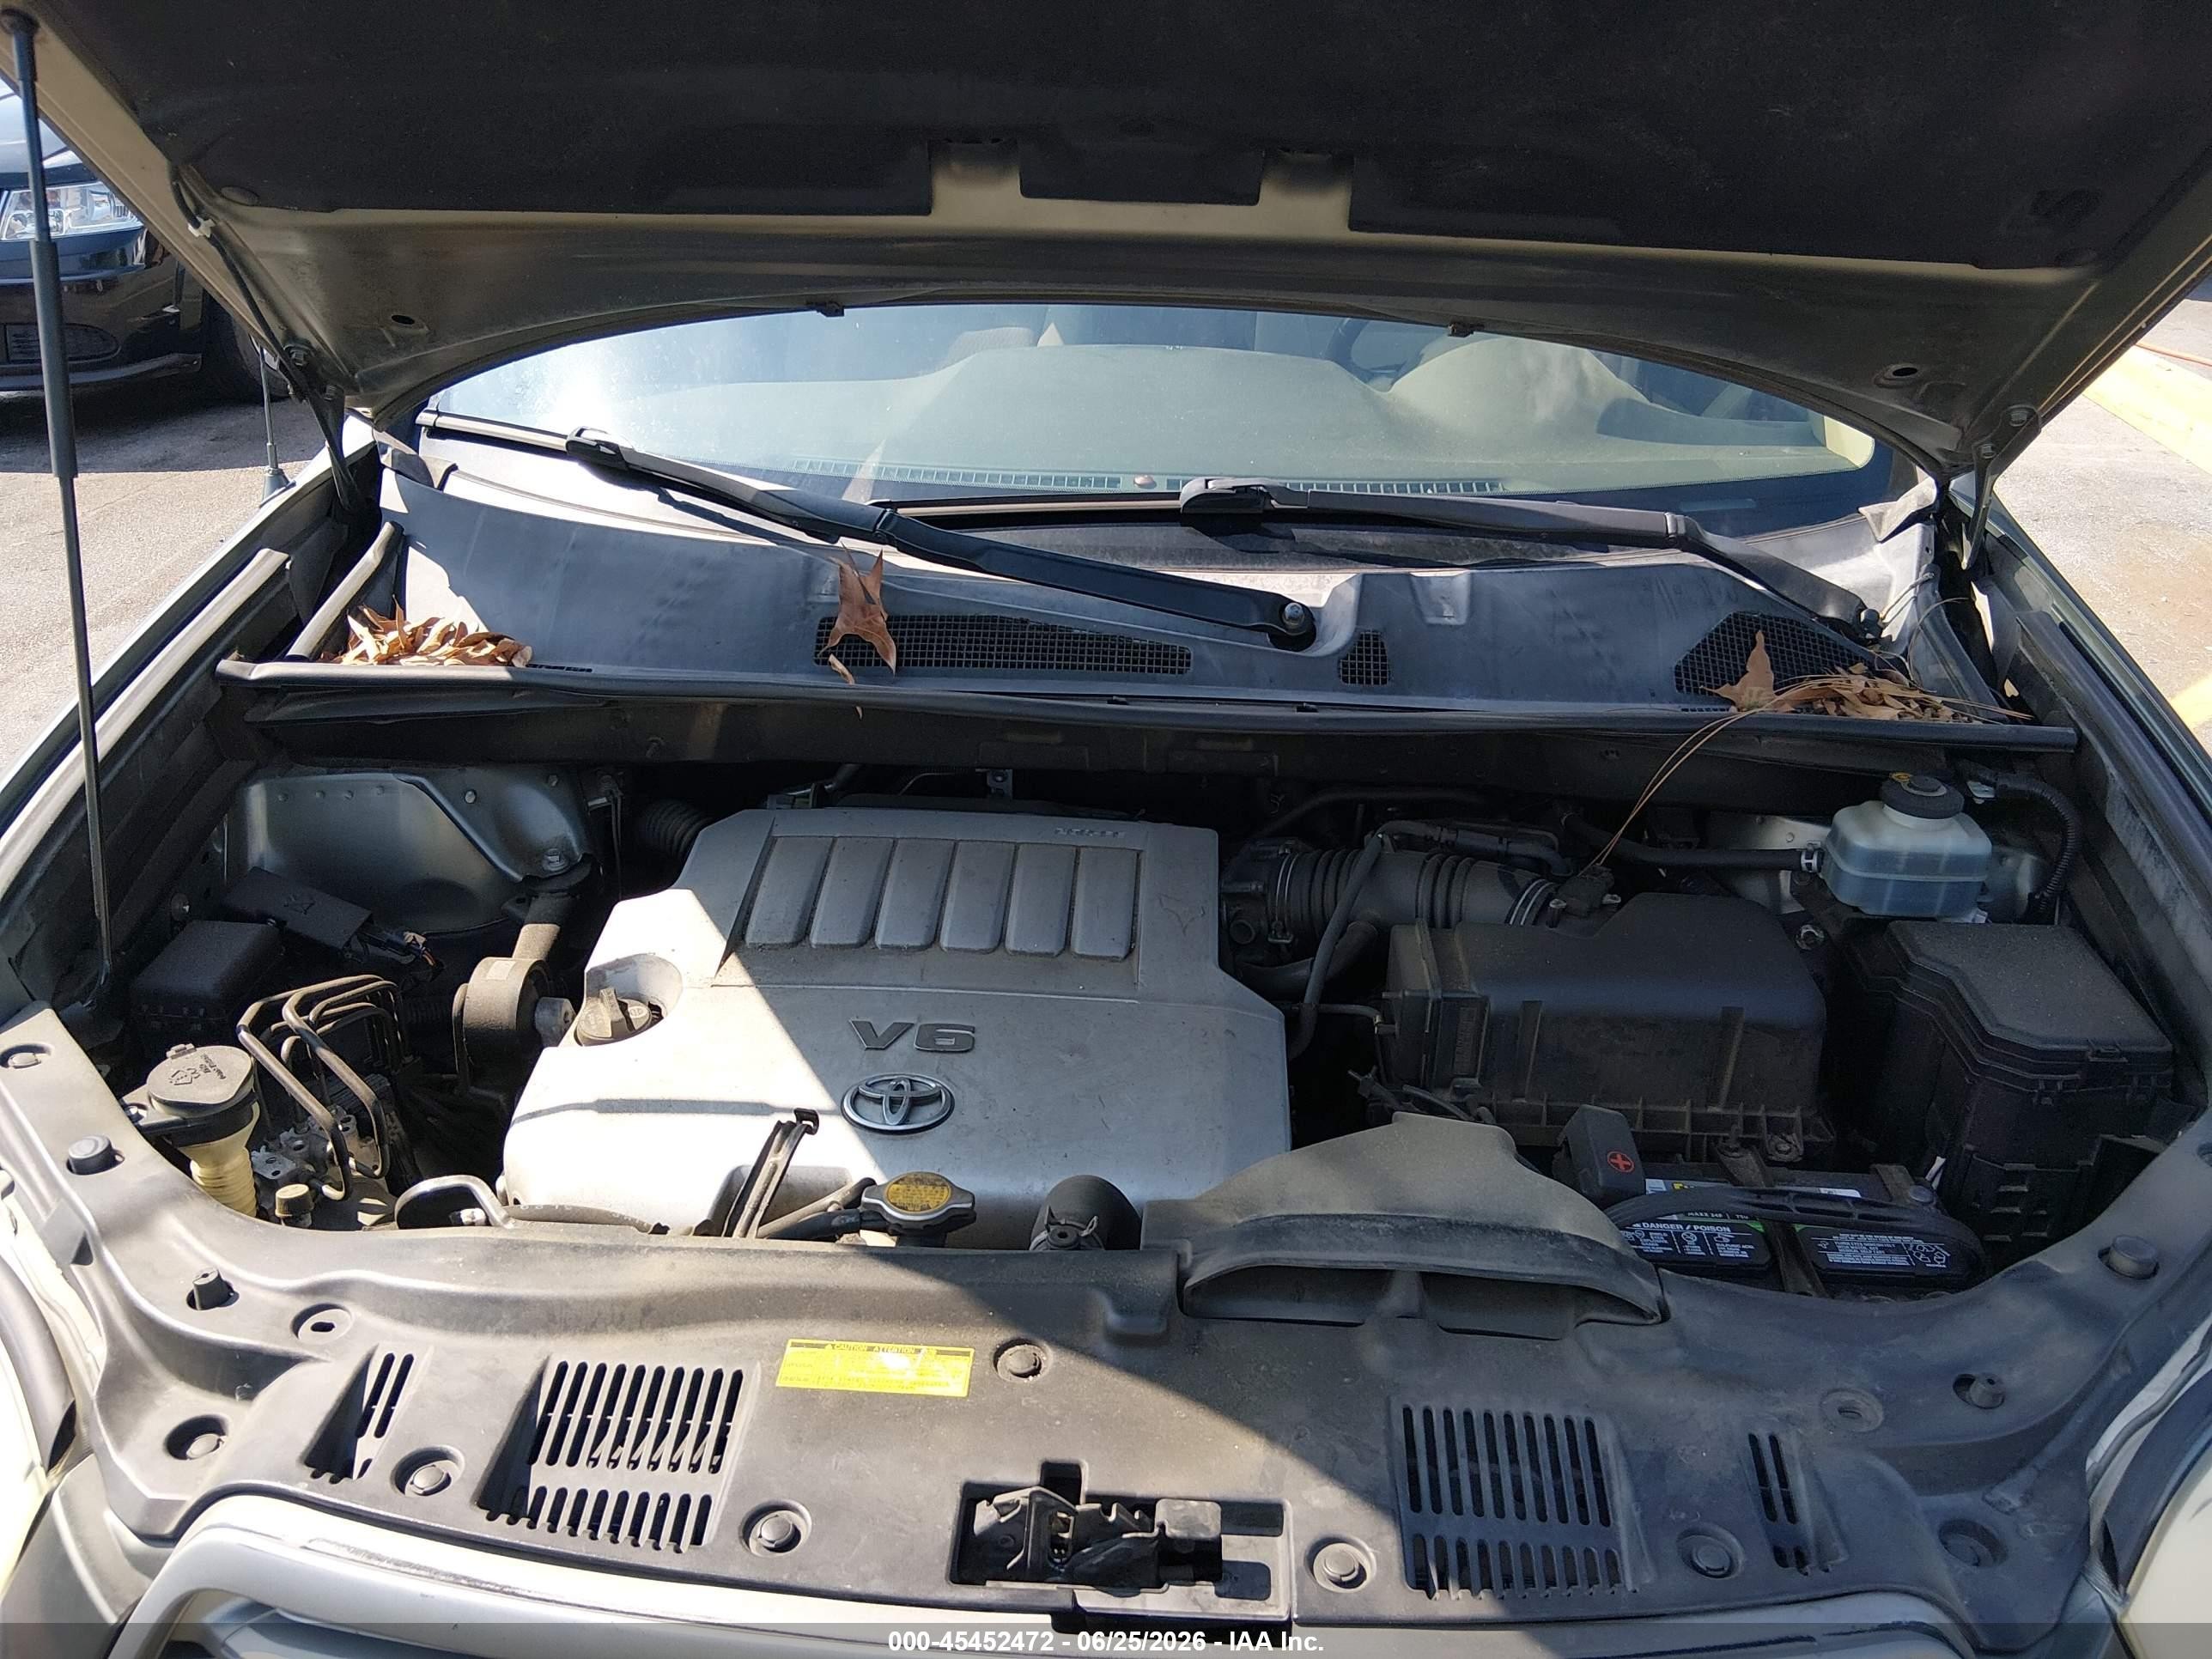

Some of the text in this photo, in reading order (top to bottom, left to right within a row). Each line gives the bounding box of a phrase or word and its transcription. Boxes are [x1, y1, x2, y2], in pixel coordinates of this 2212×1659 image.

[849, 1018, 975, 1053] V6
[1642, 1222, 1684, 1231] DANGER
[1693, 1224, 1731, 1233] POISON
[835, 1343, 915, 1354] CAUTION ATTENTION
